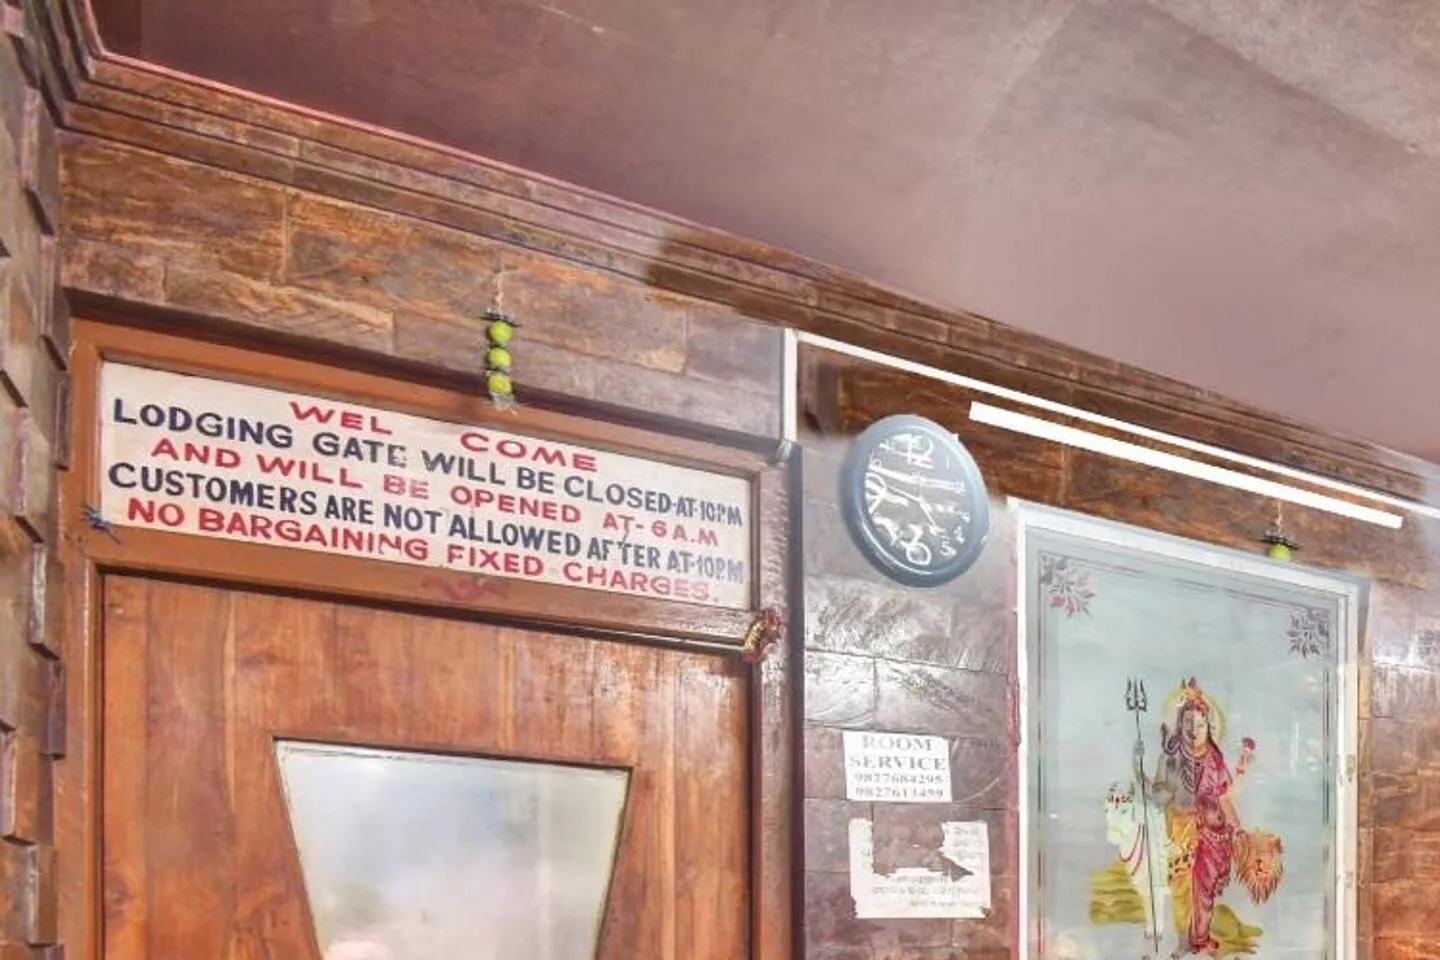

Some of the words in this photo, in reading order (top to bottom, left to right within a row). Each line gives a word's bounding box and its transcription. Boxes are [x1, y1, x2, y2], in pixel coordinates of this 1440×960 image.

[113, 398, 293, 449] LODGING
[312, 432, 407, 468] GATE
[421, 450, 505, 485] WILL
[517, 466, 555, 494] BE
[290, 401, 393, 435] WEL
[460, 432, 598, 473] COME
[108, 462, 317, 515] CUSTOMERS
[325, 495, 373, 525] ARE
[384, 503, 442, 534] NOT
[449, 515, 581, 557] ALLOWED
[587, 536, 661, 569] AFTER
[151, 438, 241, 468] AND
[256, 454, 362, 489] WILL
[383, 474, 429, 500] BE
[451, 485, 581, 523] OPENED
[128, 497, 185, 527] NO
[199, 508, 429, 561] BARGAINING
[447, 544, 544, 577] FIXED
[850, 755, 947, 771] SERVICE
[862, 735, 933, 751] ROOM
